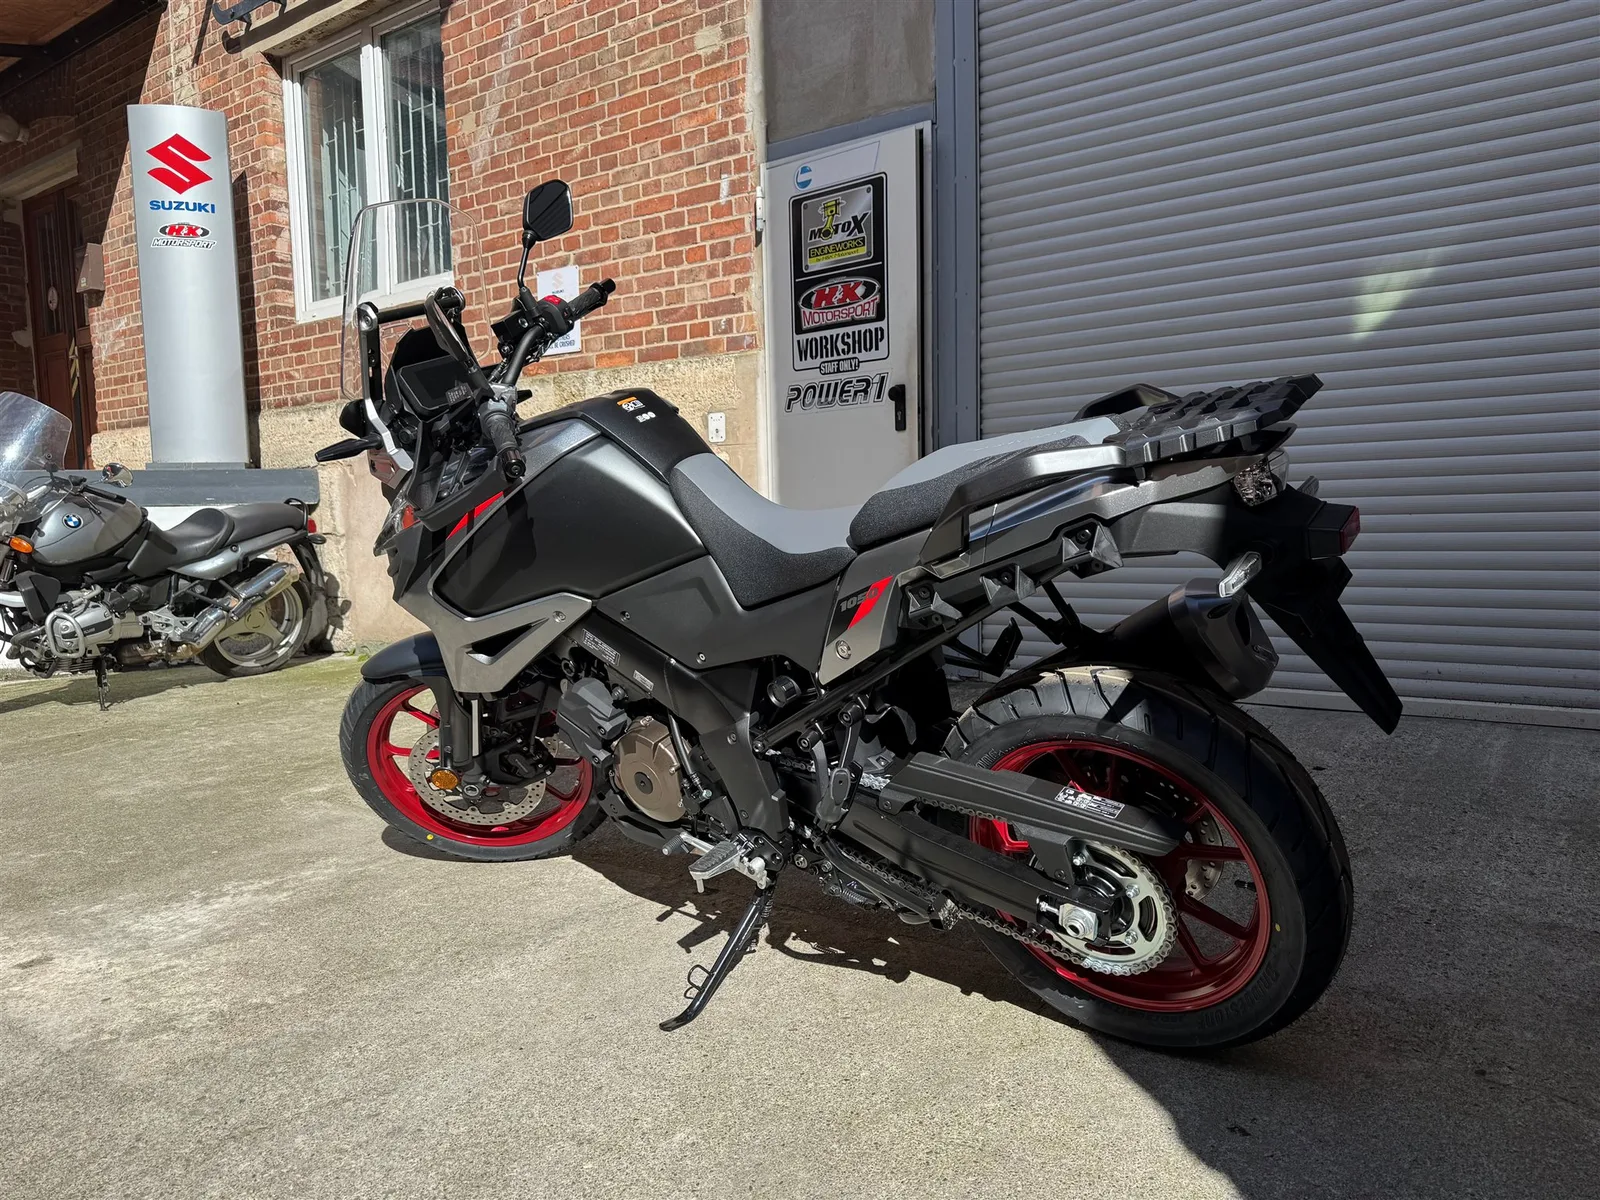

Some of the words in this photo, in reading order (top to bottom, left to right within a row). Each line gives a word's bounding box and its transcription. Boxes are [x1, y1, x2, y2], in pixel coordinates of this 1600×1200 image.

[149, 200, 216, 214] SUZUKI
[152, 238, 216, 249] MOTORSPORT
[810, 238, 864, 257] ENGINEWORKS
[803, 297, 880, 327] MOTORSPORT
[797, 327, 885, 362] WORKSHOP
[820, 361, 839, 374] STAFF
[840, 358, 859, 371] ONLY!
[785, 372, 888, 412] POWER1
[840, 587, 879, 612] 1050
